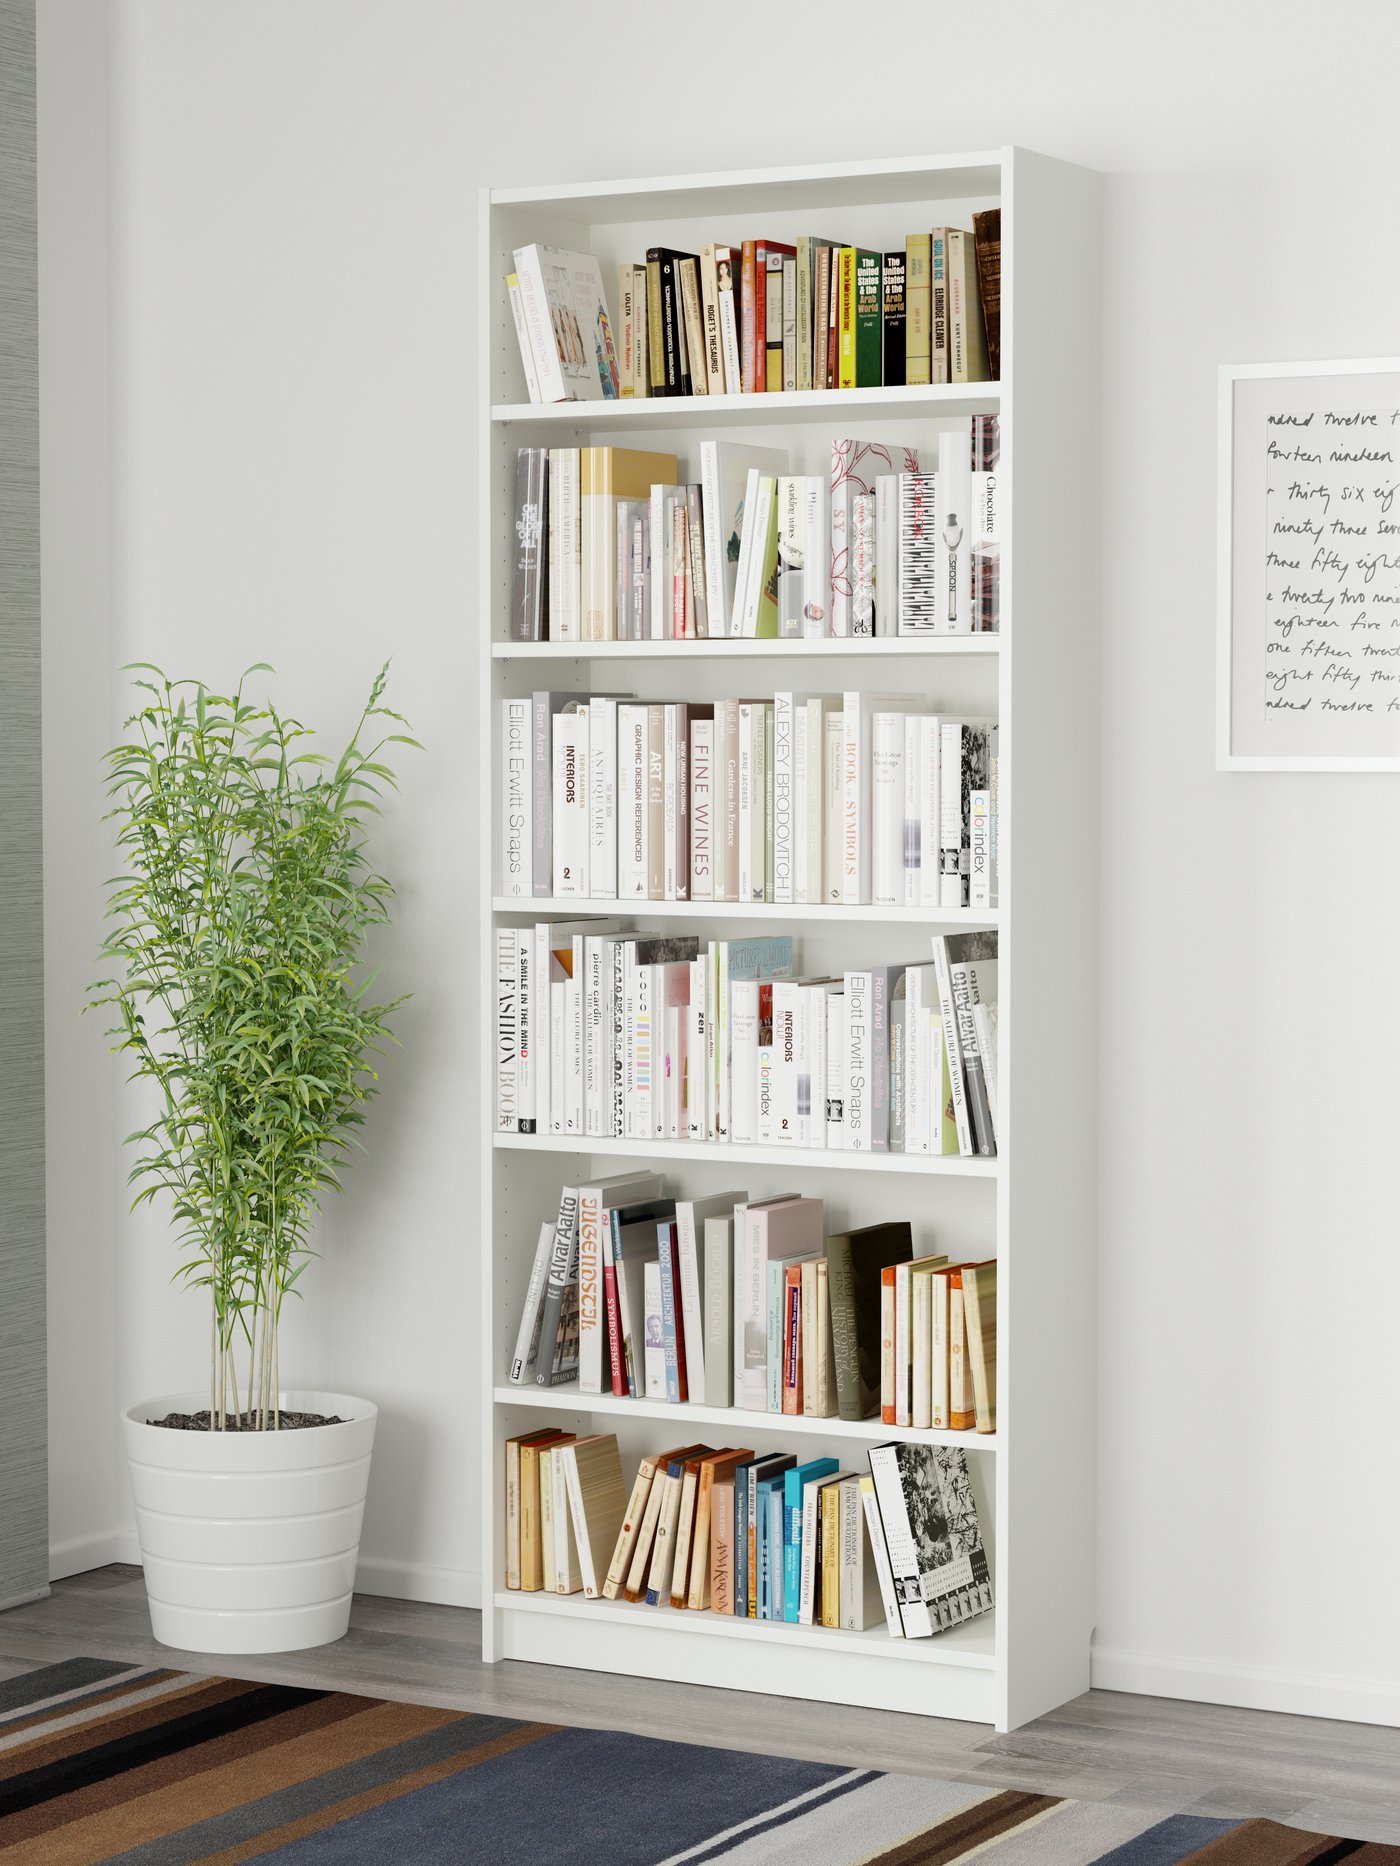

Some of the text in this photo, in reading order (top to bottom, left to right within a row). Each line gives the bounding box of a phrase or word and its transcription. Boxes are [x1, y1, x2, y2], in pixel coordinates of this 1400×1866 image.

[663, 264, 671, 274] 6
[857, 266, 880, 277] United
[861, 258, 875, 268] The
[883, 265, 905, 277] United
[887, 257, 900, 267] The
[857, 275, 879, 287] States
[859, 285, 877, 295] & the
[883, 275, 905, 286] States
[885, 284, 903, 295] & the
[933, 239, 945, 349] SOUL ON ICE ELDRIDGE CLEAVER
[624, 292, 632, 317] LOLITA
[857, 303, 879, 314] World
[859, 294, 877, 304] Arab
[883, 302, 905, 313] World
[885, 293, 903, 304] Arab
[707, 304, 719, 374] ROGET'S THESAURUS
[624, 347, 632, 370] Nabokov
[1324, 411, 1379, 426] twelve
[1267, 440, 1394, 464] fourteen nineteen
[522, 504, 538, 513] OH
[787, 482, 798, 539] sparkling wines
[913, 479, 924, 540] KOKBOK
[986, 476, 997, 533] Chocolate
[1287, 481, 1331, 515] thirty
[1340, 485, 1365, 502] six
[515, 521, 543, 531] GLORY
[521, 512, 538, 522] THE
[1273, 516, 1325, 546] ninety
[1329, 518, 1367, 536] three
[518, 530, 532, 540] OF
[520, 539, 537, 549] ALL
[949, 560, 957, 592] SPOON
[1266, 551, 1300, 569] three
[1311, 546, 1349, 583] fifty
[1281, 585, 1335, 615] twenty
[1339, 587, 1365, 605] two
[1273, 606, 1381, 638] eighteen five
[1266, 642, 1292, 653] one
[1301, 639, 1352, 658] fifteen
[1265, 668, 1314, 691] eight
[1321, 663, 1361, 691] fifty
[1320, 698, 1375, 712] twelve
[756, 714, 764, 739] TEXTILE
[566, 745, 575, 803] INTERIORS
[650, 751, 662, 782] ART
[679, 741, 687, 815] NEW URBAN HOUSING
[741, 751, 749, 810] ARNE JACOBSEN
[506, 704, 525, 873] Elliott Erwitt Snaps
[593, 748, 604, 847] ANTIQUAIRES
[634, 724, 643, 862] GRAPHIC DESIGN REFERENCED
[727, 759, 736, 847] Gardens in France
[776, 697, 790, 889] ALEXEY BRODOVITCH
[666, 783, 675, 833] BORDEAUX
[694, 745, 709, 876] FINE WINES
[974, 797, 988, 874] colorindex
[563, 867, 571, 880] 2
[520, 947, 528, 956] A
[520, 958, 528, 990] SMILE
[592, 953, 601, 987] pierre
[520, 993, 528, 1005] IN
[592, 990, 602, 1025] cardin
[953, 971, 978, 1054] Alvar Aalto
[498, 931, 516, 1127] THE FASHION BOOK
[520, 1007, 528, 1027] THE
[698, 1011, 706, 1034] zen
[776, 1010, 785, 1040] NOW!
[520, 1029, 528, 1058] MIND
[784, 1010, 793, 1062] INTERIORS
[626, 1048, 633, 1059] OF
[847, 976, 865, 1129] Elliott Erwitt Snaps
[942, 998, 963, 1107] THE ALLURE OF WOMEN
[760, 1051, 772, 1116] colorindex
[782, 1119, 789, 1130] 2
[549, 1196, 578, 1282] Alvar Aalto
[659, 1240, 671, 1268] 2000
[581, 1198, 598, 1332] JUGENDSTIL
[751, 1224, 760, 1317] MIES IN BERLIN
[841, 1249, 854, 1301] MICHAEL
[661, 1272, 675, 1326] ARCHITEKTUR
[834, 1271, 845, 1301] KING
[606, 1297, 620, 1377] SYMBOLISMUS
[664, 1335, 677, 1367] BERLIN
[831, 1306, 844, 1392] NEW ZEALAND
[836, 1305, 851, 1371] HISTORY of
[846, 1307, 860, 1384] THE PENGUIN
[511, 1359, 522, 1379] MoMA
[785, 1505, 793, 1546] CONVERSATIONS
[791, 1507, 801, 1545] difficult
[844, 1486, 852, 1566] FAMOUS QUOTATIONS
[866, 1497, 882, 1550] American Design
[851, 1558, 858, 1567] OF
